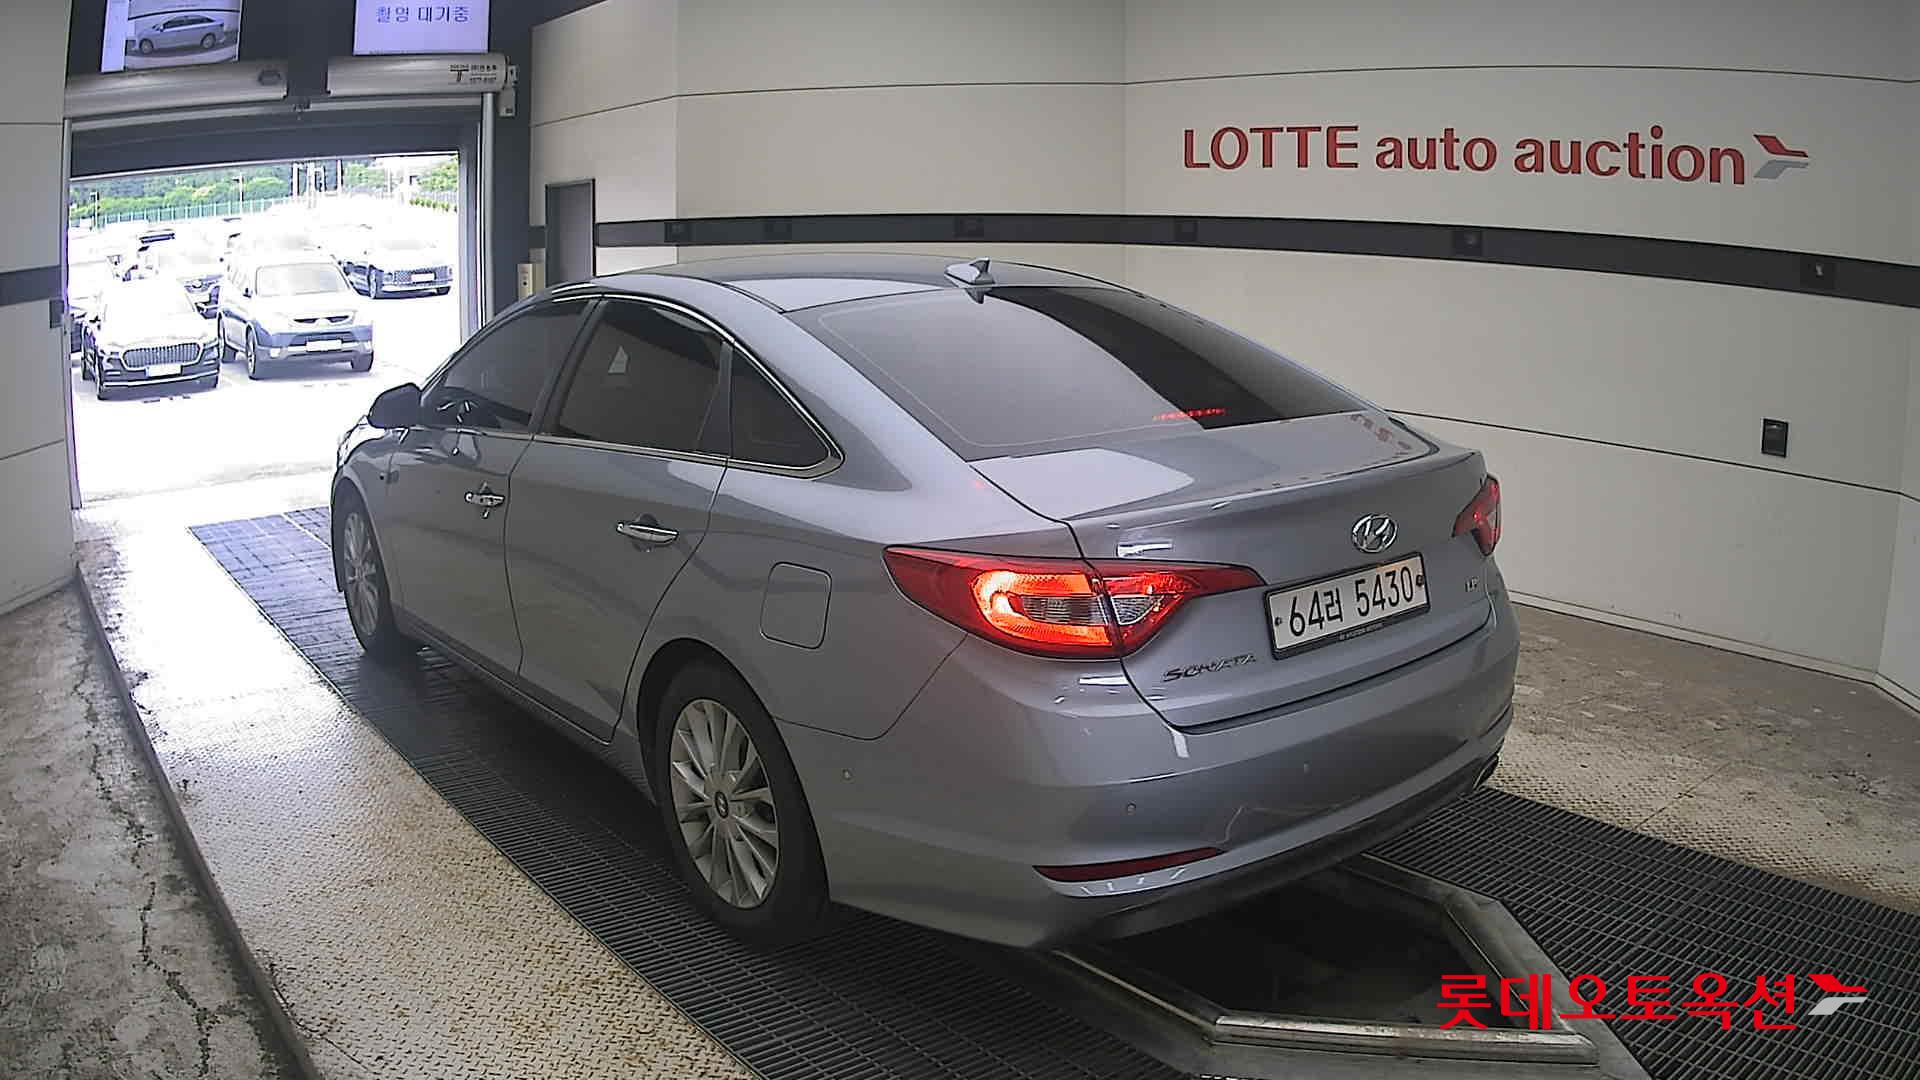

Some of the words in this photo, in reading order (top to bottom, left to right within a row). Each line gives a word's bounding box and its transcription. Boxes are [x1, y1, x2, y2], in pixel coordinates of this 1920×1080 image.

[418, 6, 469, 22] 대기중
[1184, 126, 1359, 169] LOTTE
[1376, 127, 1496, 173] auto
[1514, 125, 1744, 185] auction
[1289, 587, 1343, 637] 64러
[1354, 566, 1414, 617] 5430
